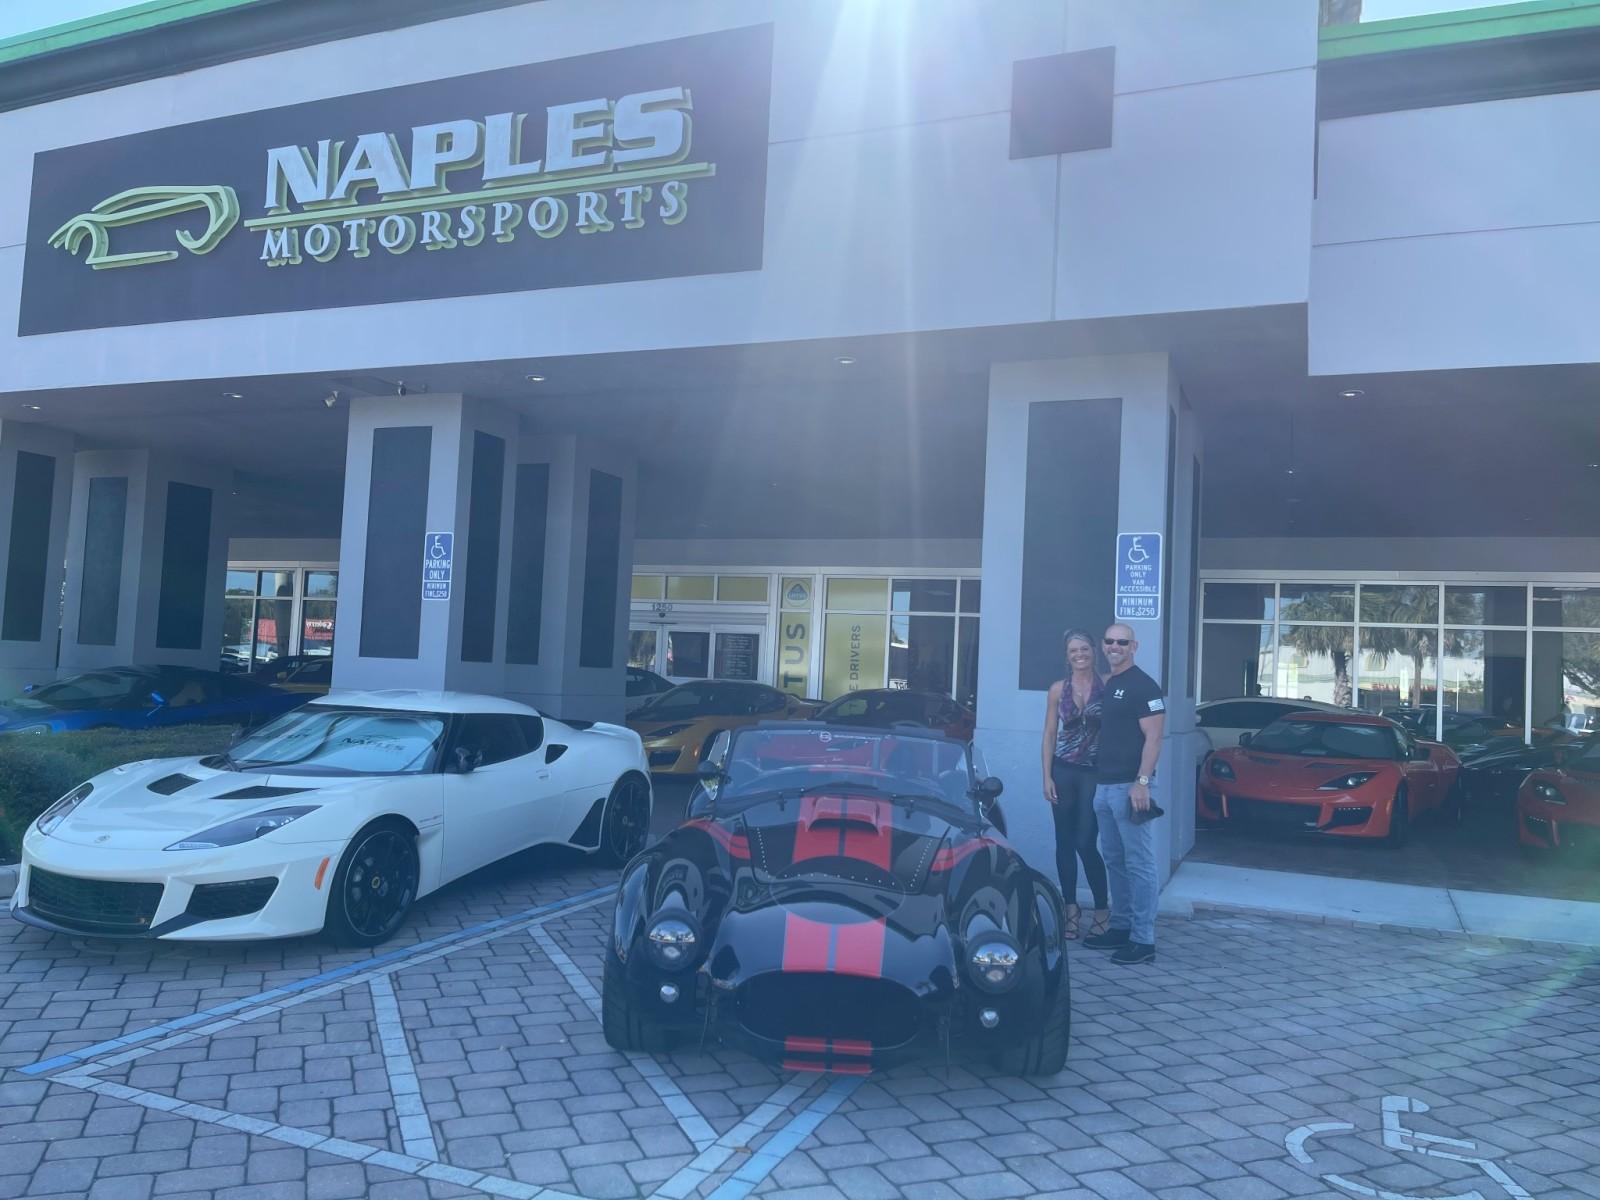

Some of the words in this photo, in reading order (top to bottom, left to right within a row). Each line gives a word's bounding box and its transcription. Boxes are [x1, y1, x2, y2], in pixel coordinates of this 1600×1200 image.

[264, 86, 692, 214] NAPLES
[260, 180, 687, 266] MOTORSPORTS
[425, 560, 451, 568] PARKING
[429, 570, 445, 579] ONLY
[652, 602, 673, 612] 1250
[1122, 598, 1152, 606] MINIMUM
[1120, 607, 1136, 616] FINE
[1137, 606, 1155, 616] $250
[849, 624, 861, 681] DRIVERS
